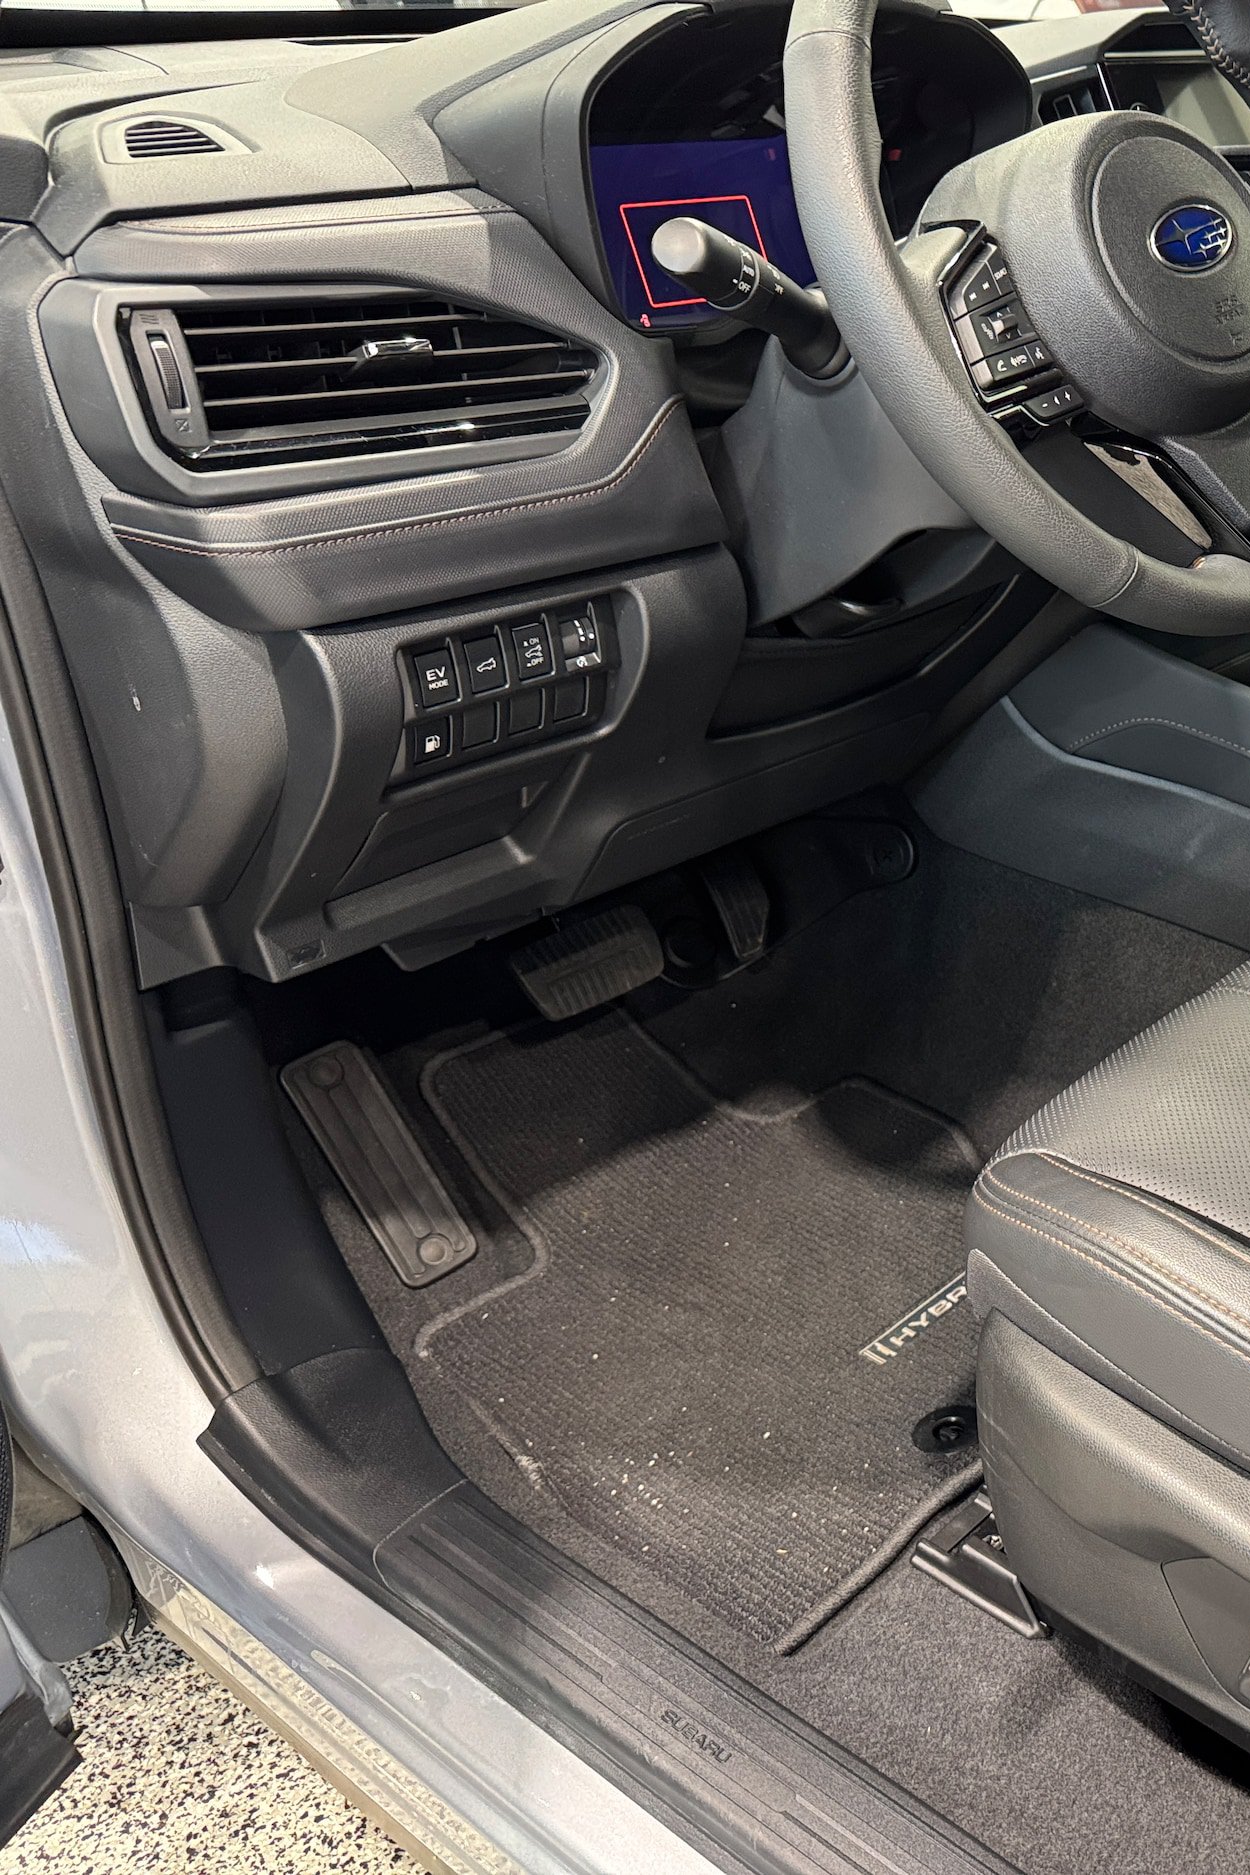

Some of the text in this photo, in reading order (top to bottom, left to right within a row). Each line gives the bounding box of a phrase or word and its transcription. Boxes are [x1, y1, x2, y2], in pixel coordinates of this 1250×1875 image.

[738, 281, 752, 293] OFF
[529, 637, 540, 645] ON
[530, 657, 544, 666] OFF
[425, 666, 445, 681] EV
[428, 679, 449, 690] MODE
[889, 1281, 968, 1347] HYBR
[661, 1709, 732, 1763] SUBARU
